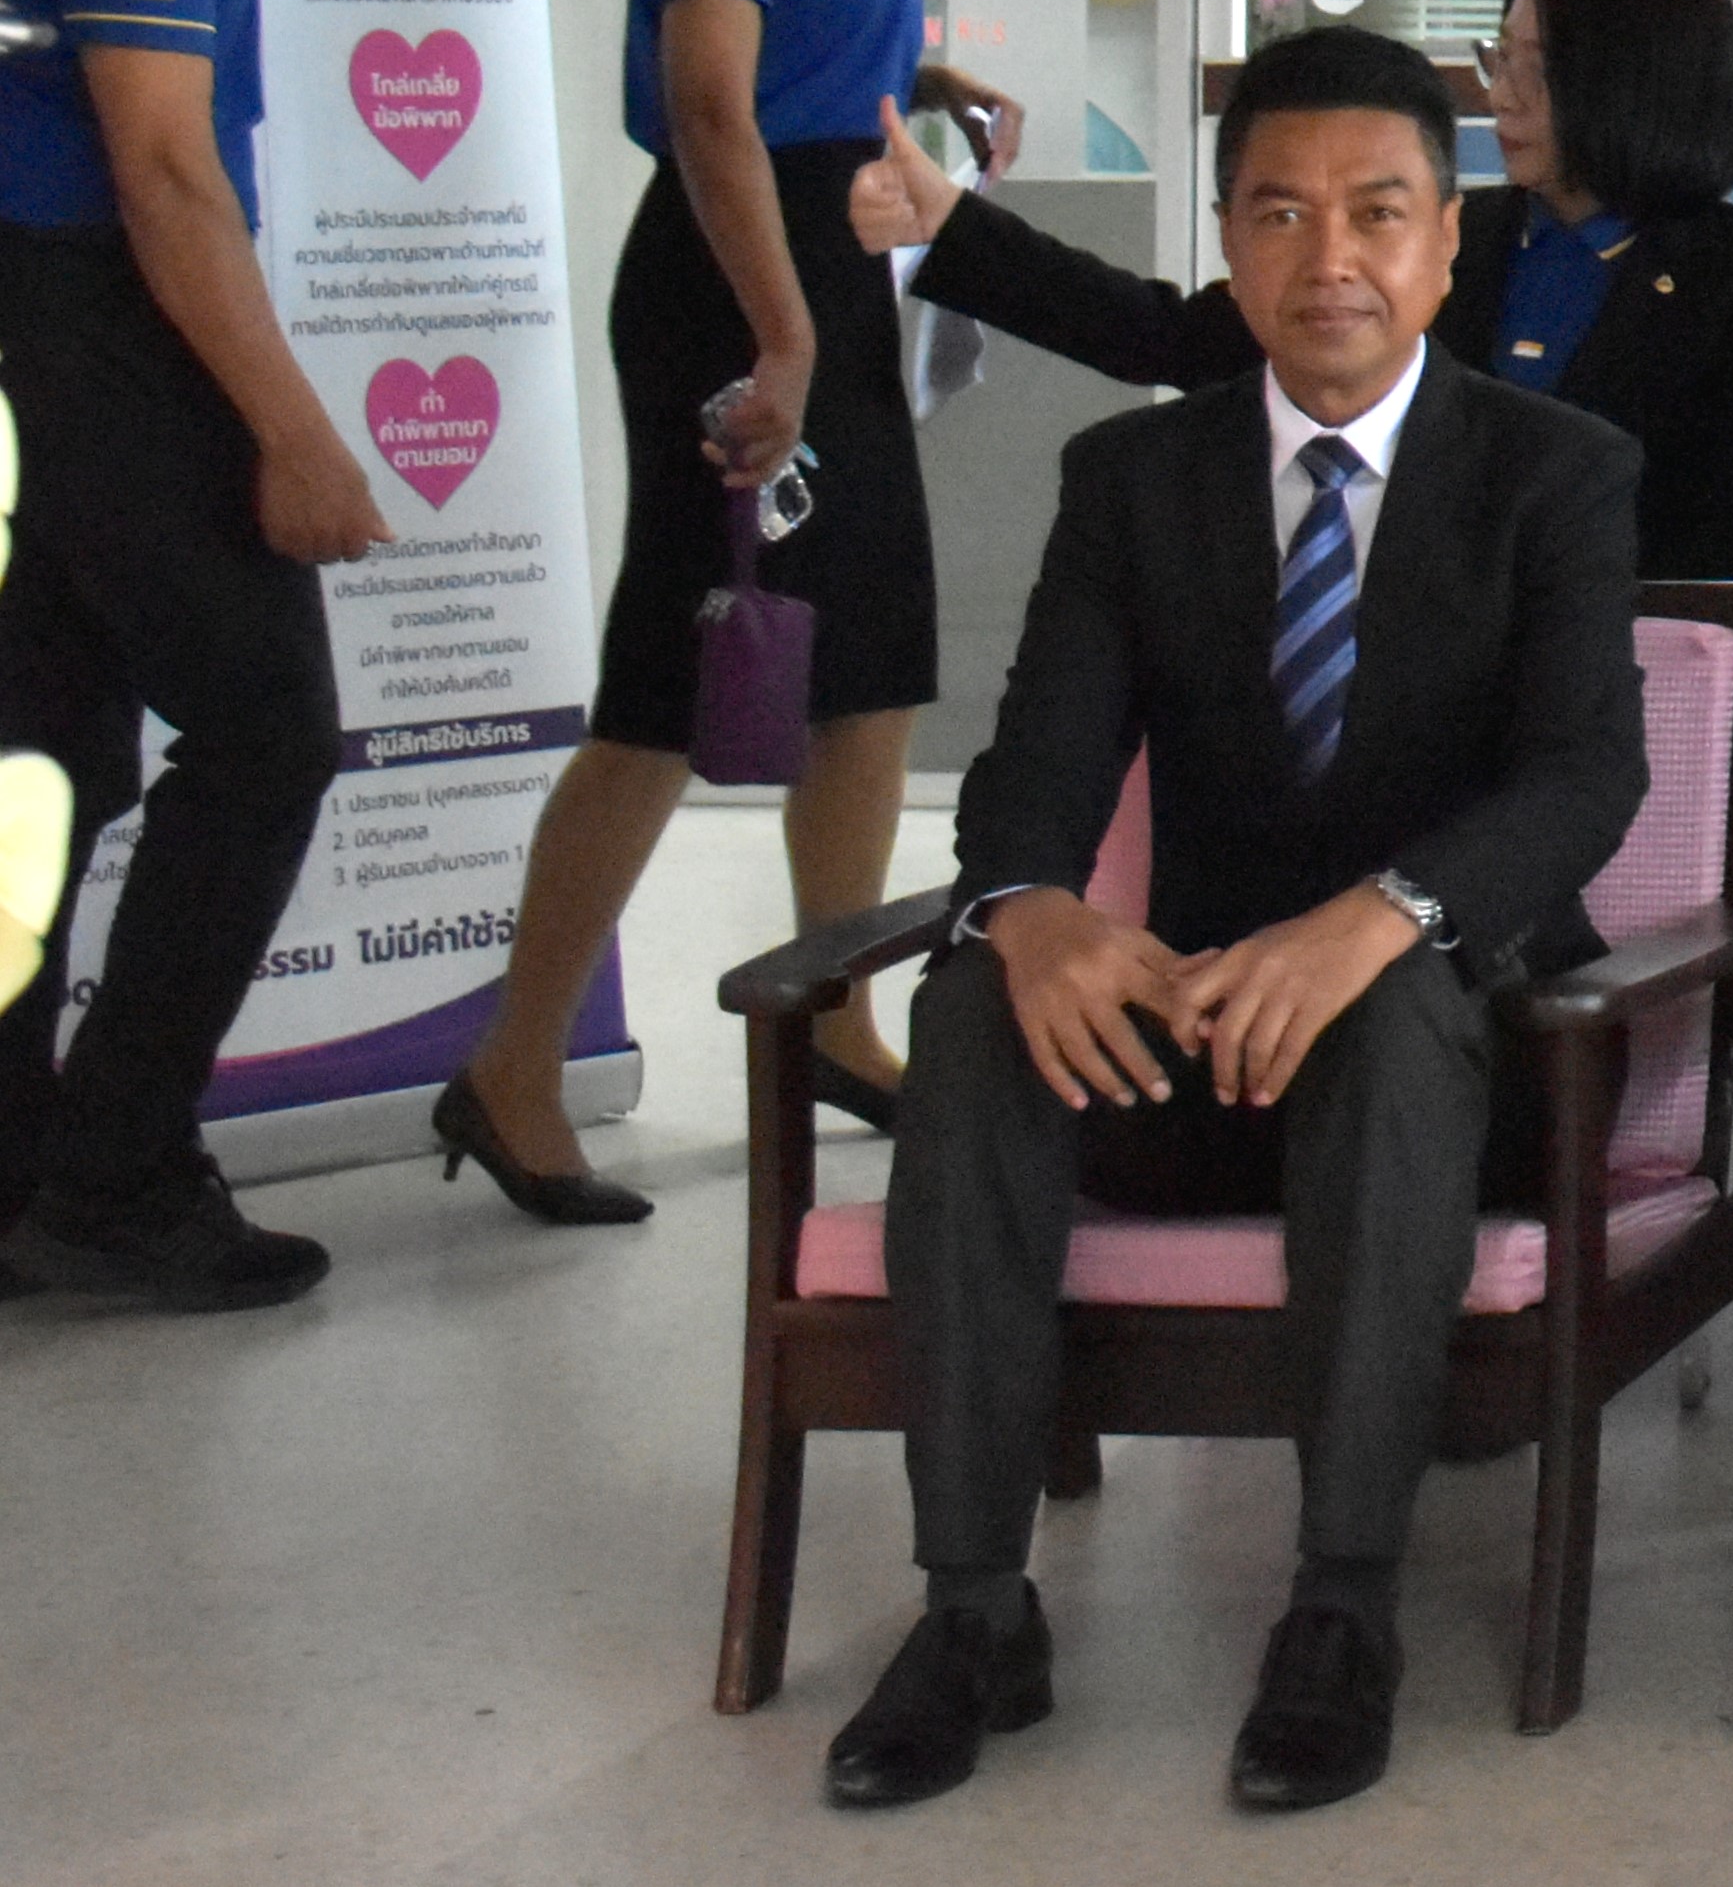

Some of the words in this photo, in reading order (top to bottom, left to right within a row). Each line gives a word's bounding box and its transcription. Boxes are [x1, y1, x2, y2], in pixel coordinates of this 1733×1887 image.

[371, 67, 460, 97] ไกล่เกลี่ย
[373, 106, 462, 129] ข้อพิพาท
[379, 416, 488, 444] คำพิพากษา
[393, 446, 478, 468] ตามยอม
[357, 907, 515, 964] ไม่มีค่าใช้จ่
